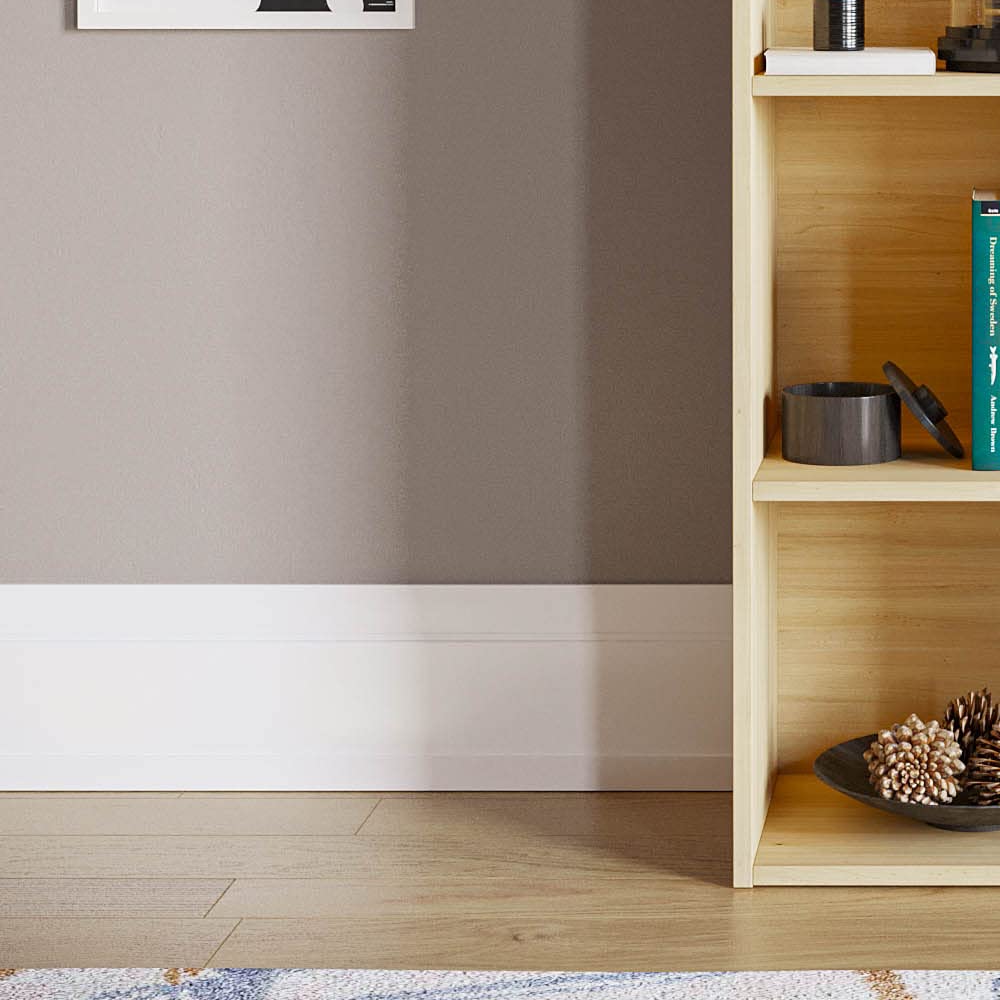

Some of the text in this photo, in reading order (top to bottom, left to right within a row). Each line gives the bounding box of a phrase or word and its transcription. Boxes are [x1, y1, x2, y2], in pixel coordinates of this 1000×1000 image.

[988, 236, 998, 336] Dreaming of Sweden
[989, 395, 998, 425] Andrew
